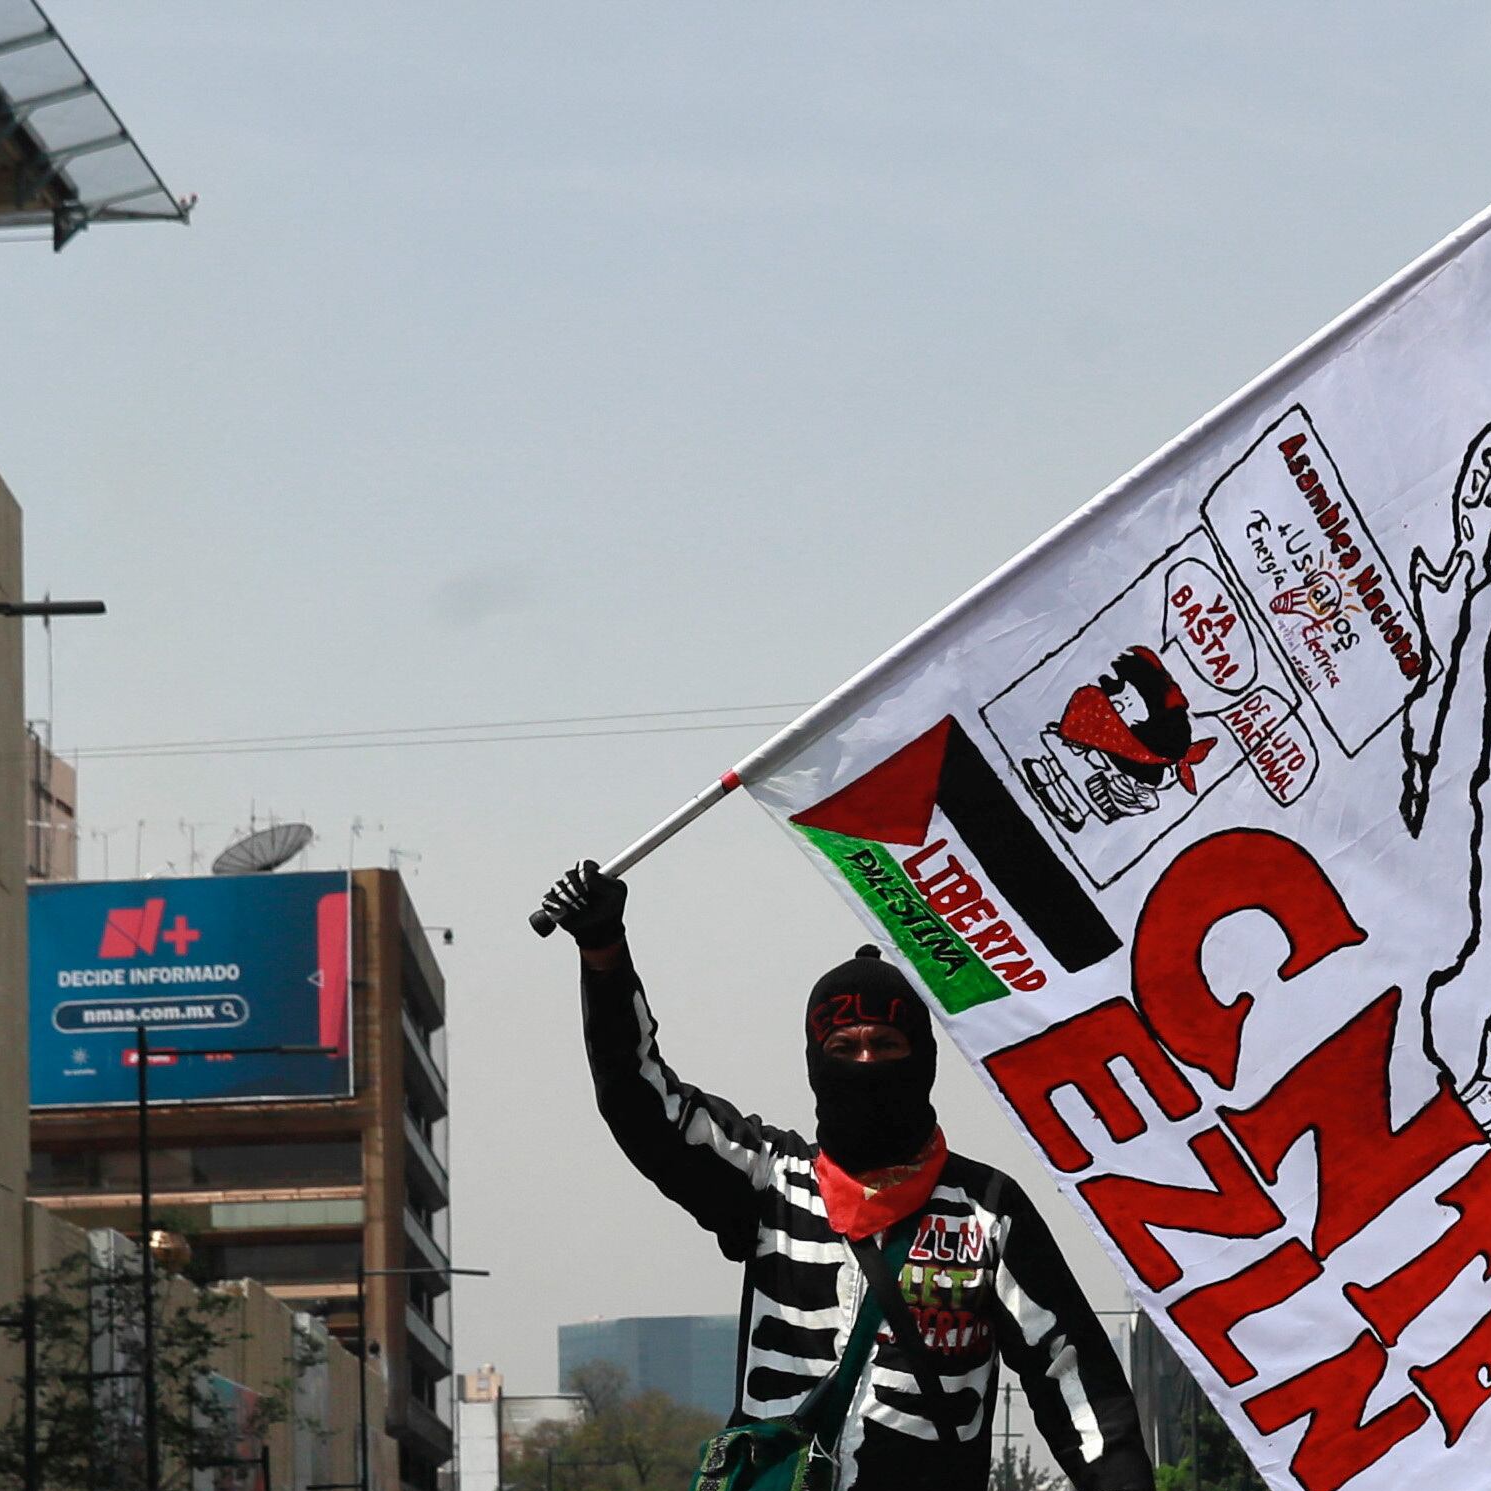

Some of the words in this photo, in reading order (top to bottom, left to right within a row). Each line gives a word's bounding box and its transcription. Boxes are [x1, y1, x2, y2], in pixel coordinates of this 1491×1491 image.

[1170, 584, 1240, 685] BASTA!
[1206, 593, 1237, 638] YA
[1225, 709, 1295, 801] NACIONAL
[1244, 694, 1271, 722] DE
[1261, 716, 1306, 772] LUTO
[843, 848, 970, 979] PALESTINA
[902, 838, 1048, 992] LIBERTAD
[58, 968, 126, 988] DECIDE
[129, 963, 241, 985] INFORMADO
[82, 1004, 216, 1024] nmas.com.mx
[907, 1213, 986, 1264] ZLN
